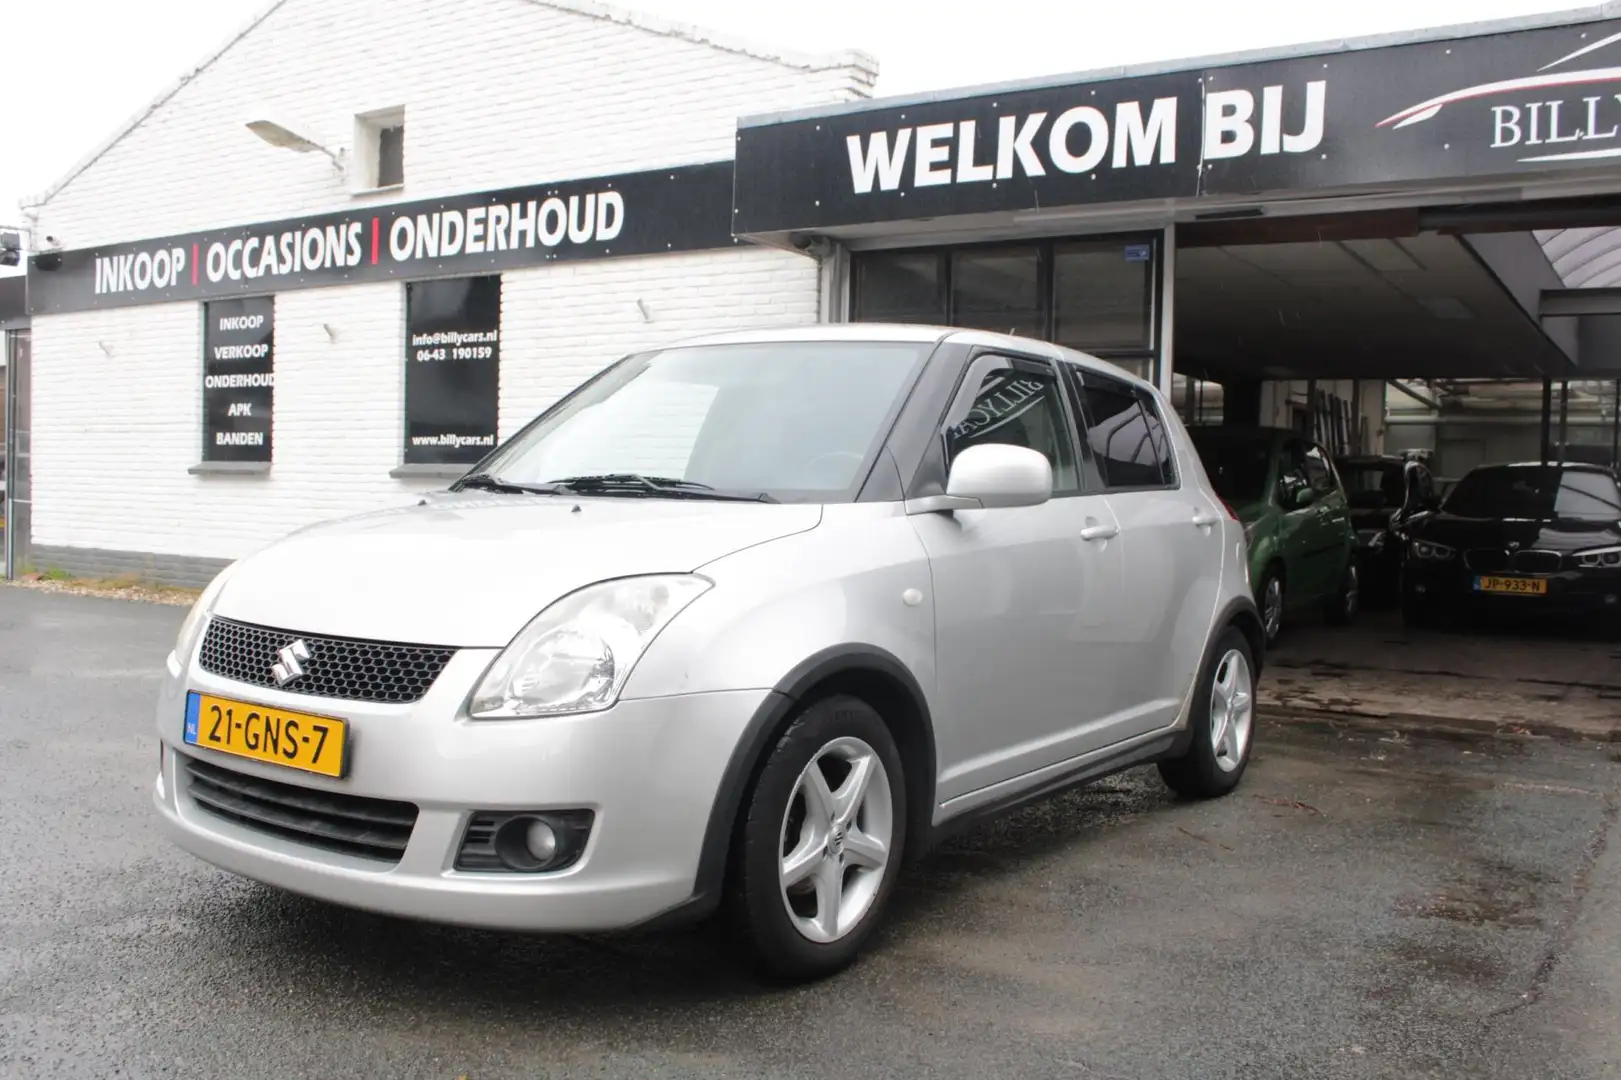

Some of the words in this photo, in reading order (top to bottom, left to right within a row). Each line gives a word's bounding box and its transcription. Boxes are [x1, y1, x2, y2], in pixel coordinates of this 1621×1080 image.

[1490, 94, 1621, 149] BILL
[846, 97, 1178, 195] WELKOM
[1202, 79, 1327, 160] BIJ
[95, 247, 185, 294] INKOOP
[206, 222, 362, 282] OCCASIONS
[389, 191, 624, 261] ONDERHOUD
[219, 315, 264, 331] INKOOP
[412, 329, 498, 346] info@billycars.nl
[214, 344, 269, 360] VERKOOP
[416, 348, 446, 362] 06-43
[452, 346, 492, 360] 190159
[228, 403, 252, 417] APK
[216, 432, 264, 446] BANDEN
[412, 433, 494, 449] www.billycars.nl
[1486, 579, 1540, 592] JP-933-N
[187, 722, 197, 735] NL
[208, 705, 329, 764] 21-GNS-7
